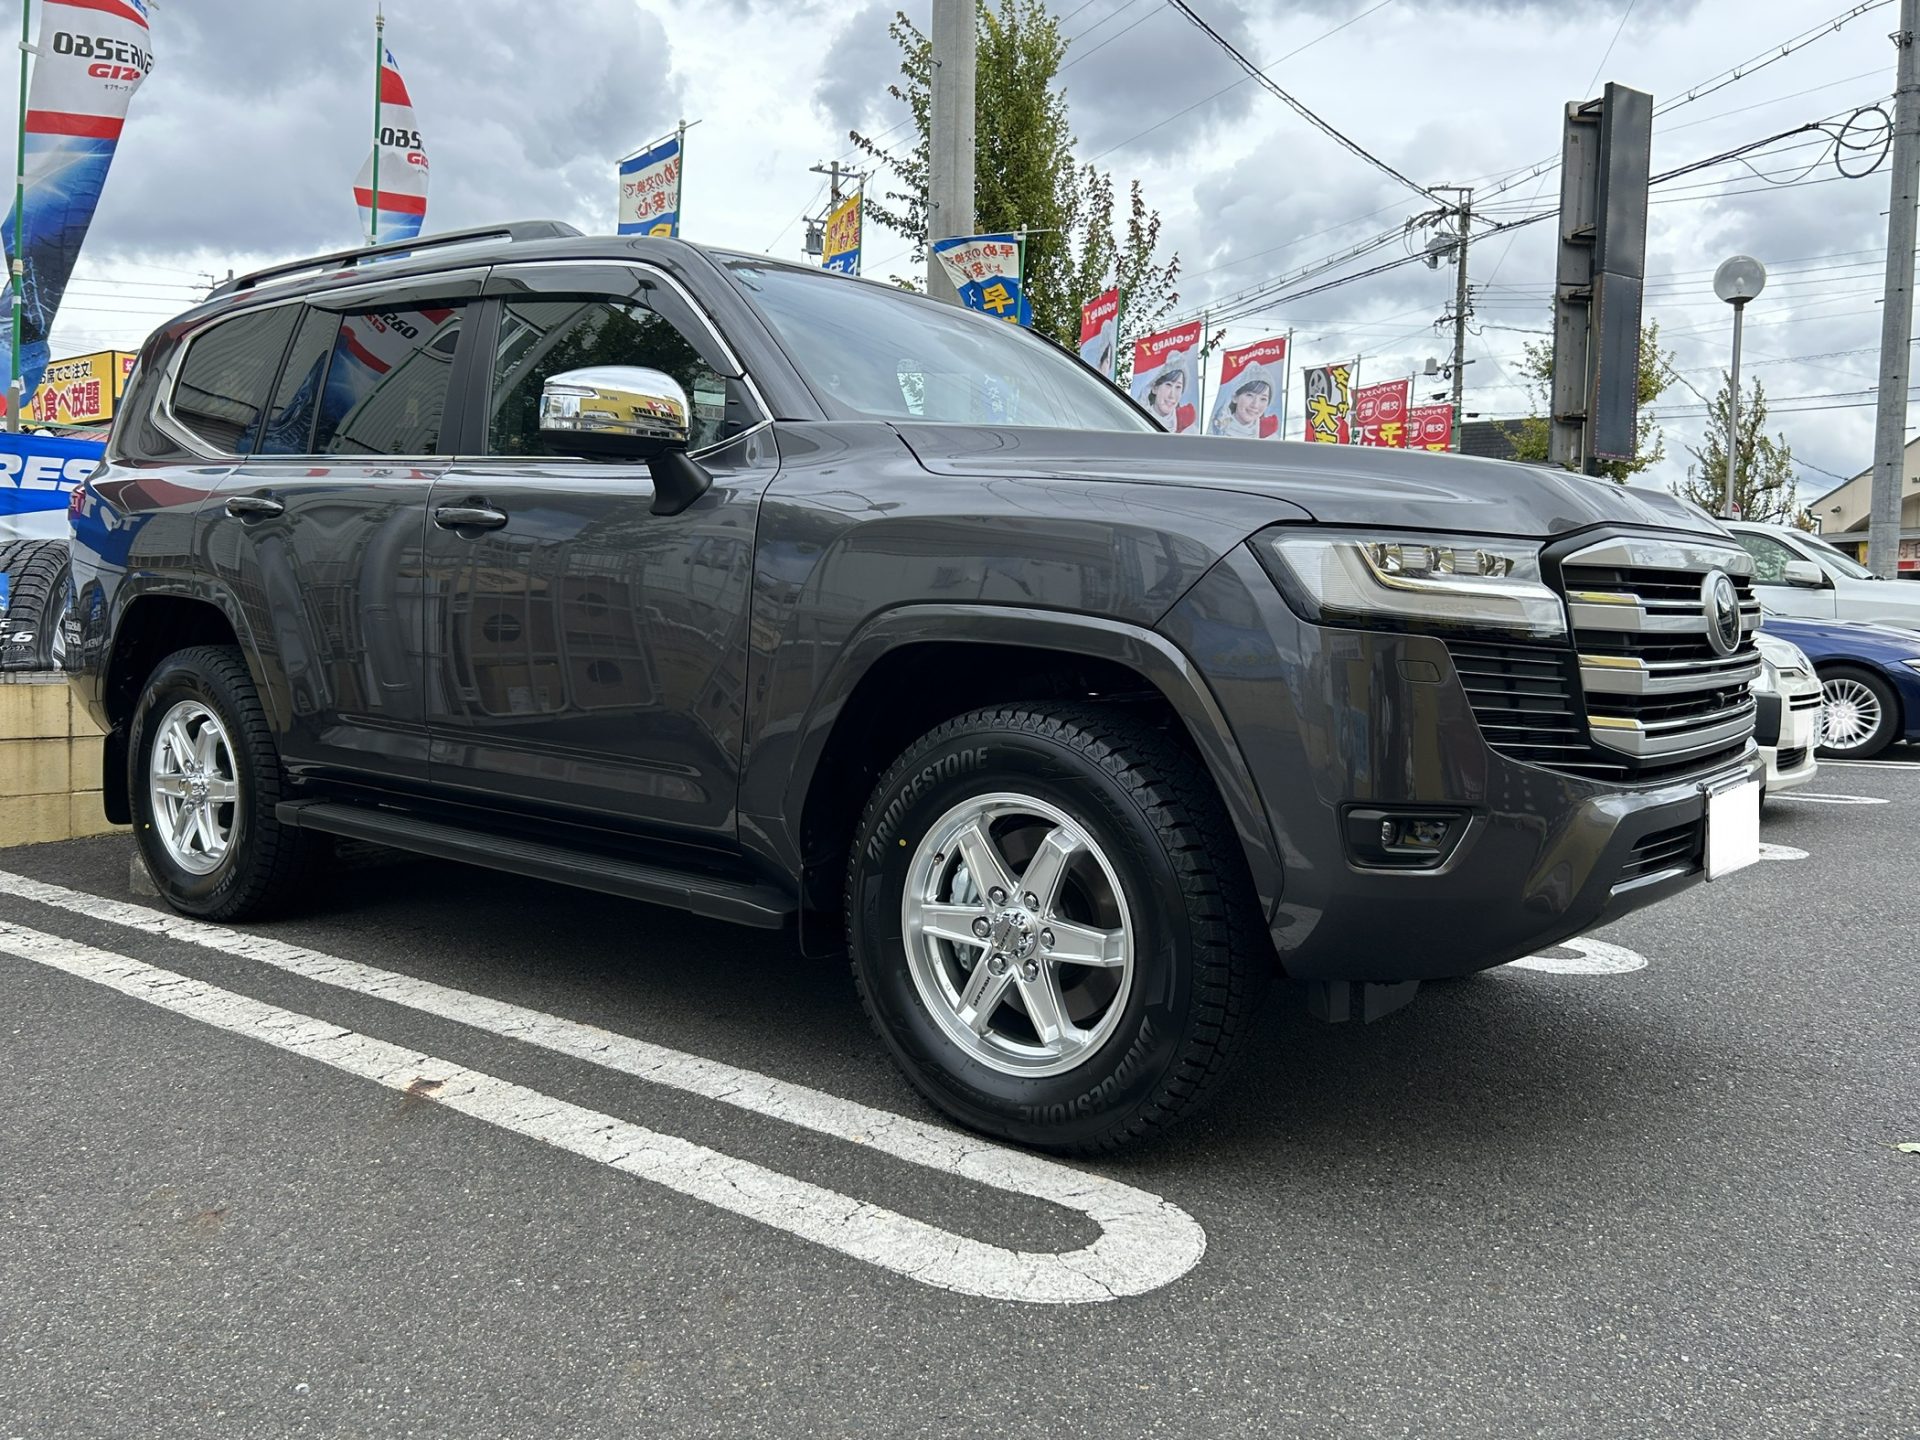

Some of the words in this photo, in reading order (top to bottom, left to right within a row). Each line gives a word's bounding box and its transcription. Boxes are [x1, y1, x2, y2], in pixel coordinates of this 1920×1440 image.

[53, 32, 153, 75] OBSERVE
[43, 380, 101, 422] 食べ放題
[866, 746, 989, 861] BRIDGESTONE
